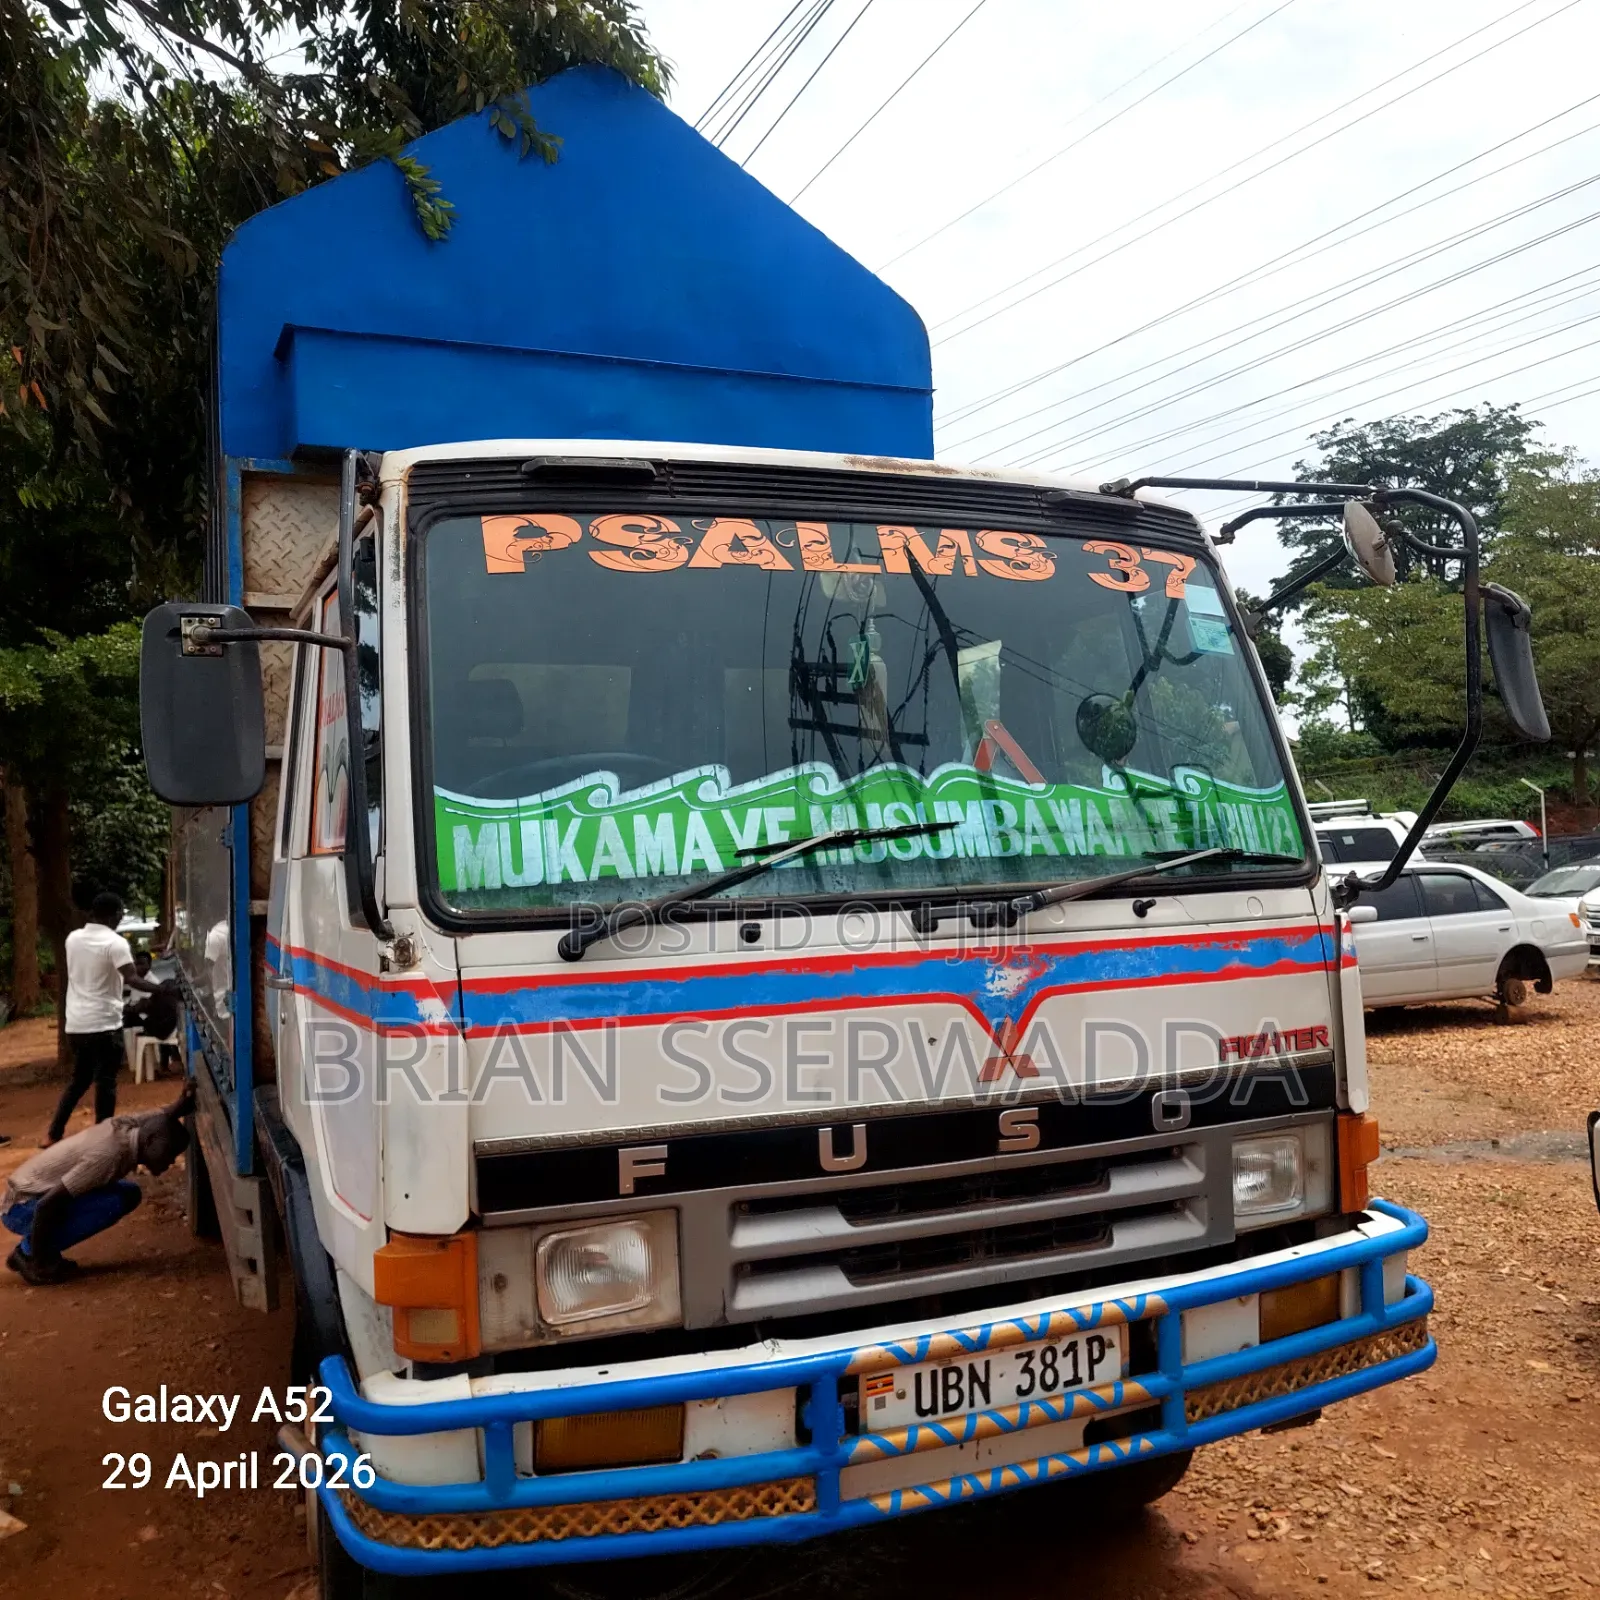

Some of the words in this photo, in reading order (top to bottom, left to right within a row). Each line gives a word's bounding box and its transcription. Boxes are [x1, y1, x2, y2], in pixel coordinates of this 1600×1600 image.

[480, 513, 1057, 582] PSALMS
[1081, 540, 1197, 600] 37
[452, 810, 725, 893] MUKAMA
[720, 806, 806, 869] YE
[808, 798, 1060, 867] MUSUMBA
[1219, 1025, 1330, 1062] FIGHTER
[618, 1088, 1192, 1195] FUSO
[914, 1359, 992, 1418] UBN
[1014, 1334, 1106, 1398] 381P
